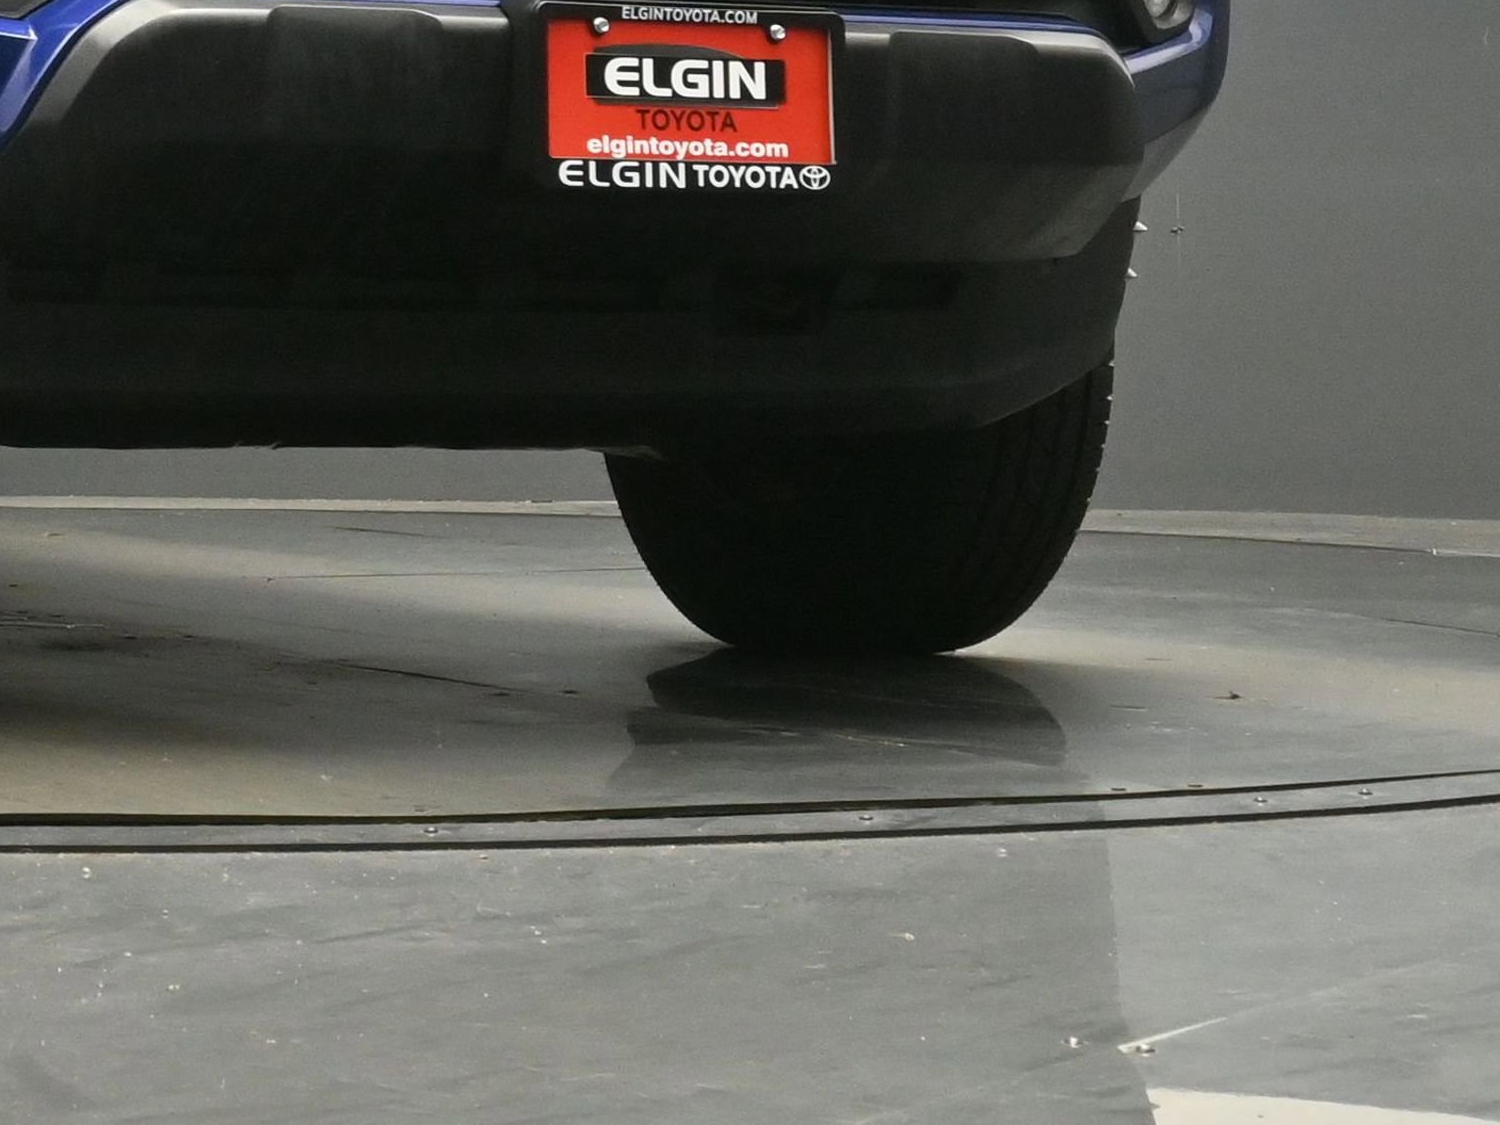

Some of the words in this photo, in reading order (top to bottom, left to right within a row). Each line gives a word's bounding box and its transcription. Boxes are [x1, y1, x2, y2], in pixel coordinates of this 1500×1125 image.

[621, 6, 758, 25] ELGINTOYOTA.COM
[603, 57, 767, 100] ELGIN
[636, 108, 738, 133] TOYOTA
[586, 135, 789, 158] elgintoyota.com
[558, 159, 687, 189] ELGIN
[692, 164, 799, 190] TOYOTA
